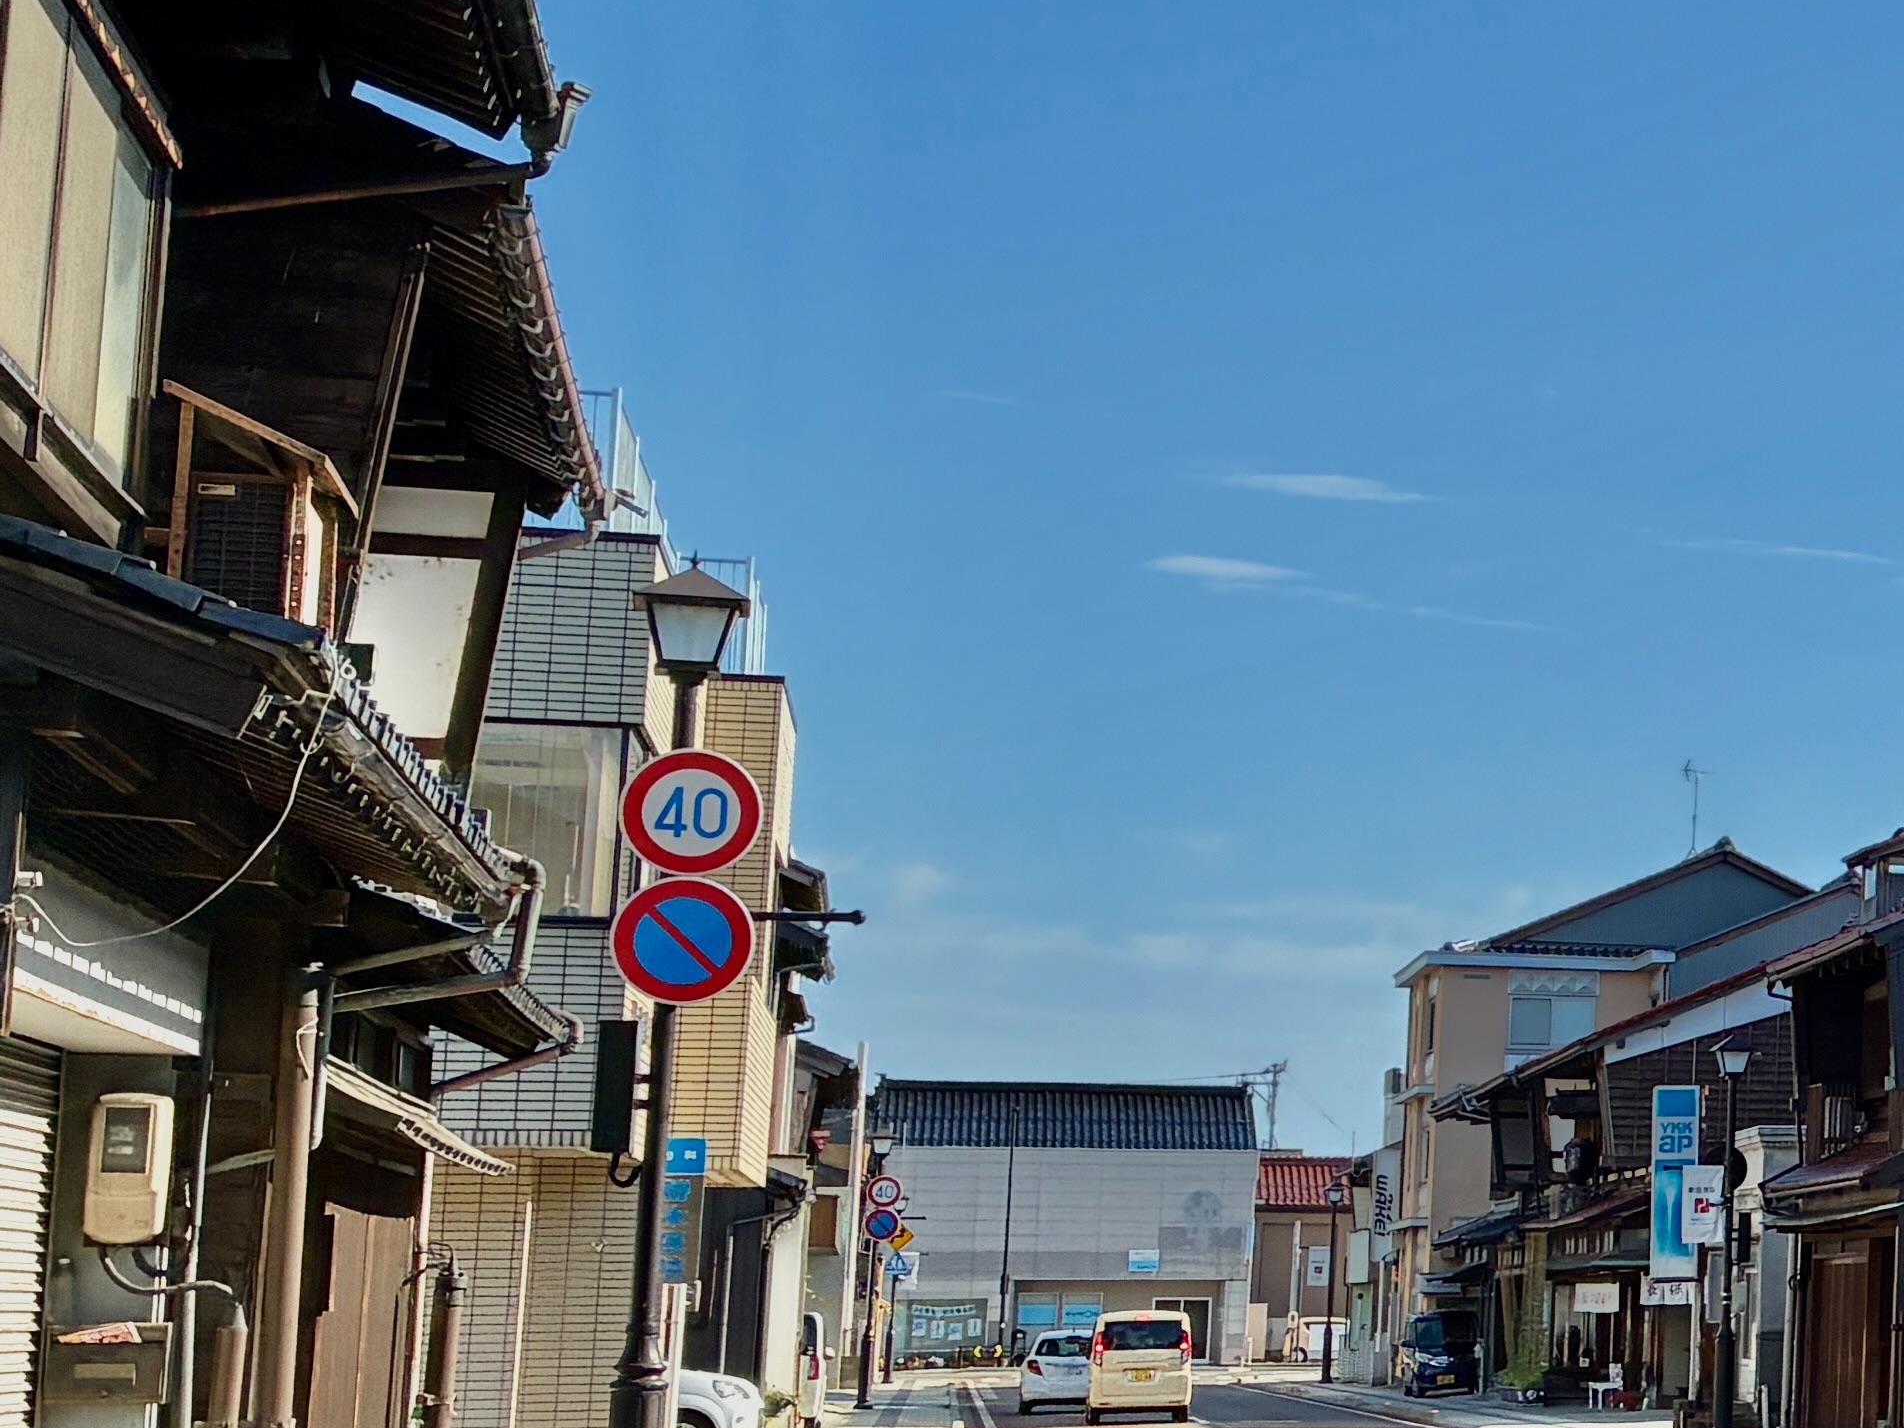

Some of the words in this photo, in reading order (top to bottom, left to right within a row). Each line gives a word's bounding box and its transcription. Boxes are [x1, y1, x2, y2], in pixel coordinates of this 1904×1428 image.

[654, 786, 728, 839] 40
[1660, 1122, 1692, 1134] YKK
[1658, 1135, 1693, 1154] ap
[876, 1185, 894, 1198] 40
